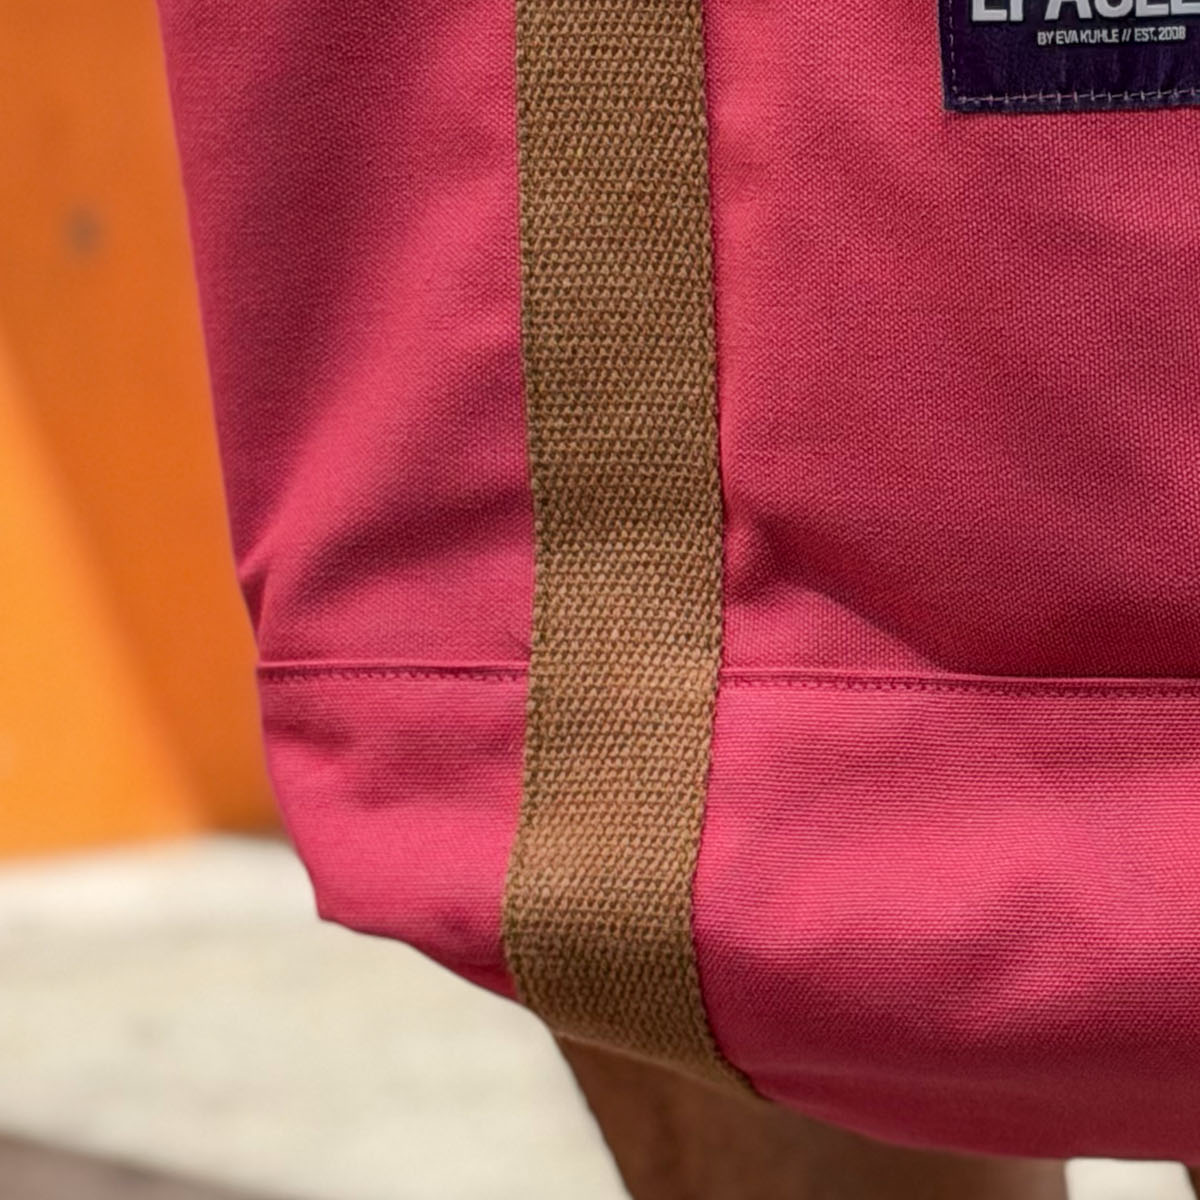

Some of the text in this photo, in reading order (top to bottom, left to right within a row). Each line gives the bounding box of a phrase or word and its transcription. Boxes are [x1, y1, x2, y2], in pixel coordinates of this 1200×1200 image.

[1037, 31, 1054, 46] BY
[1055, 29, 1079, 45] EVA
[1080, 28, 1119, 44] KUHLE
[1134, 26, 1157, 42] EST.
